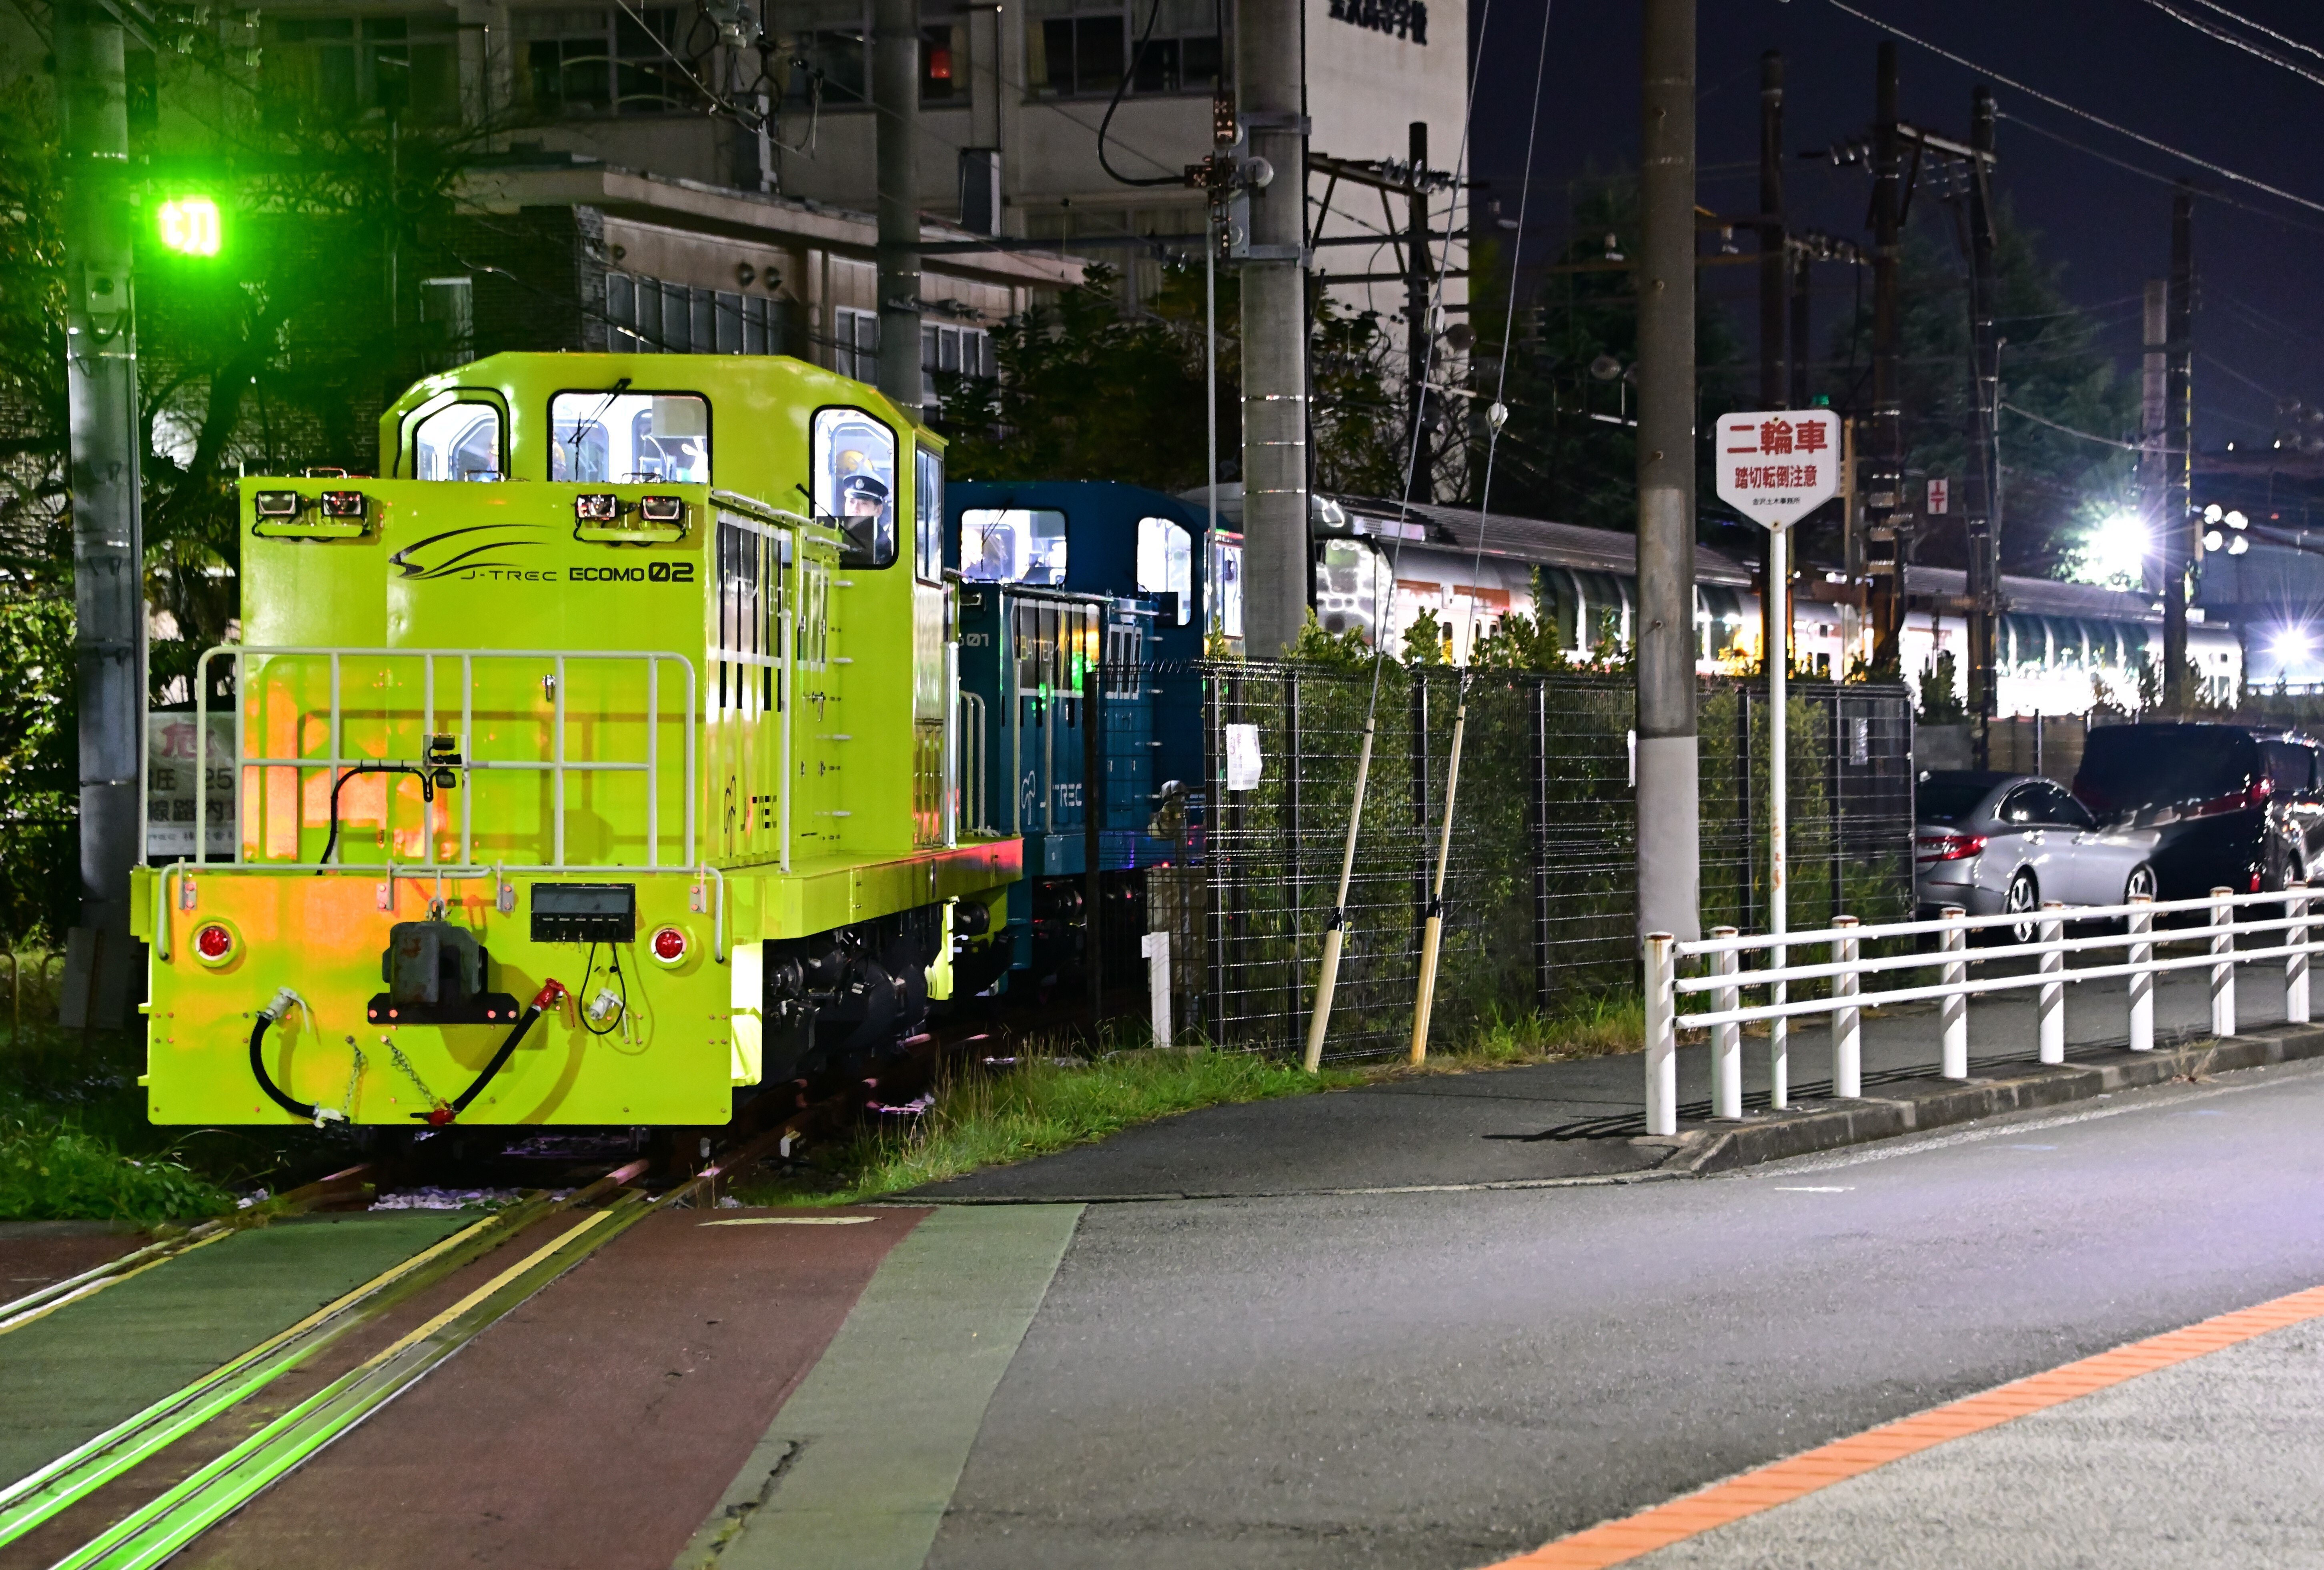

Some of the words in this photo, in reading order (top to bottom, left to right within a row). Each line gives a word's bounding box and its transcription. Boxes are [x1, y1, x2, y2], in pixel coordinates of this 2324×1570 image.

[1727, 420, 1827, 455] 二輪車
[1735, 465, 1817, 489] 踏切転倒注意
[461, 570, 557, 581] J-TREC
[569, 567, 645, 581] ECOMO
[649, 562, 694, 582] 02
